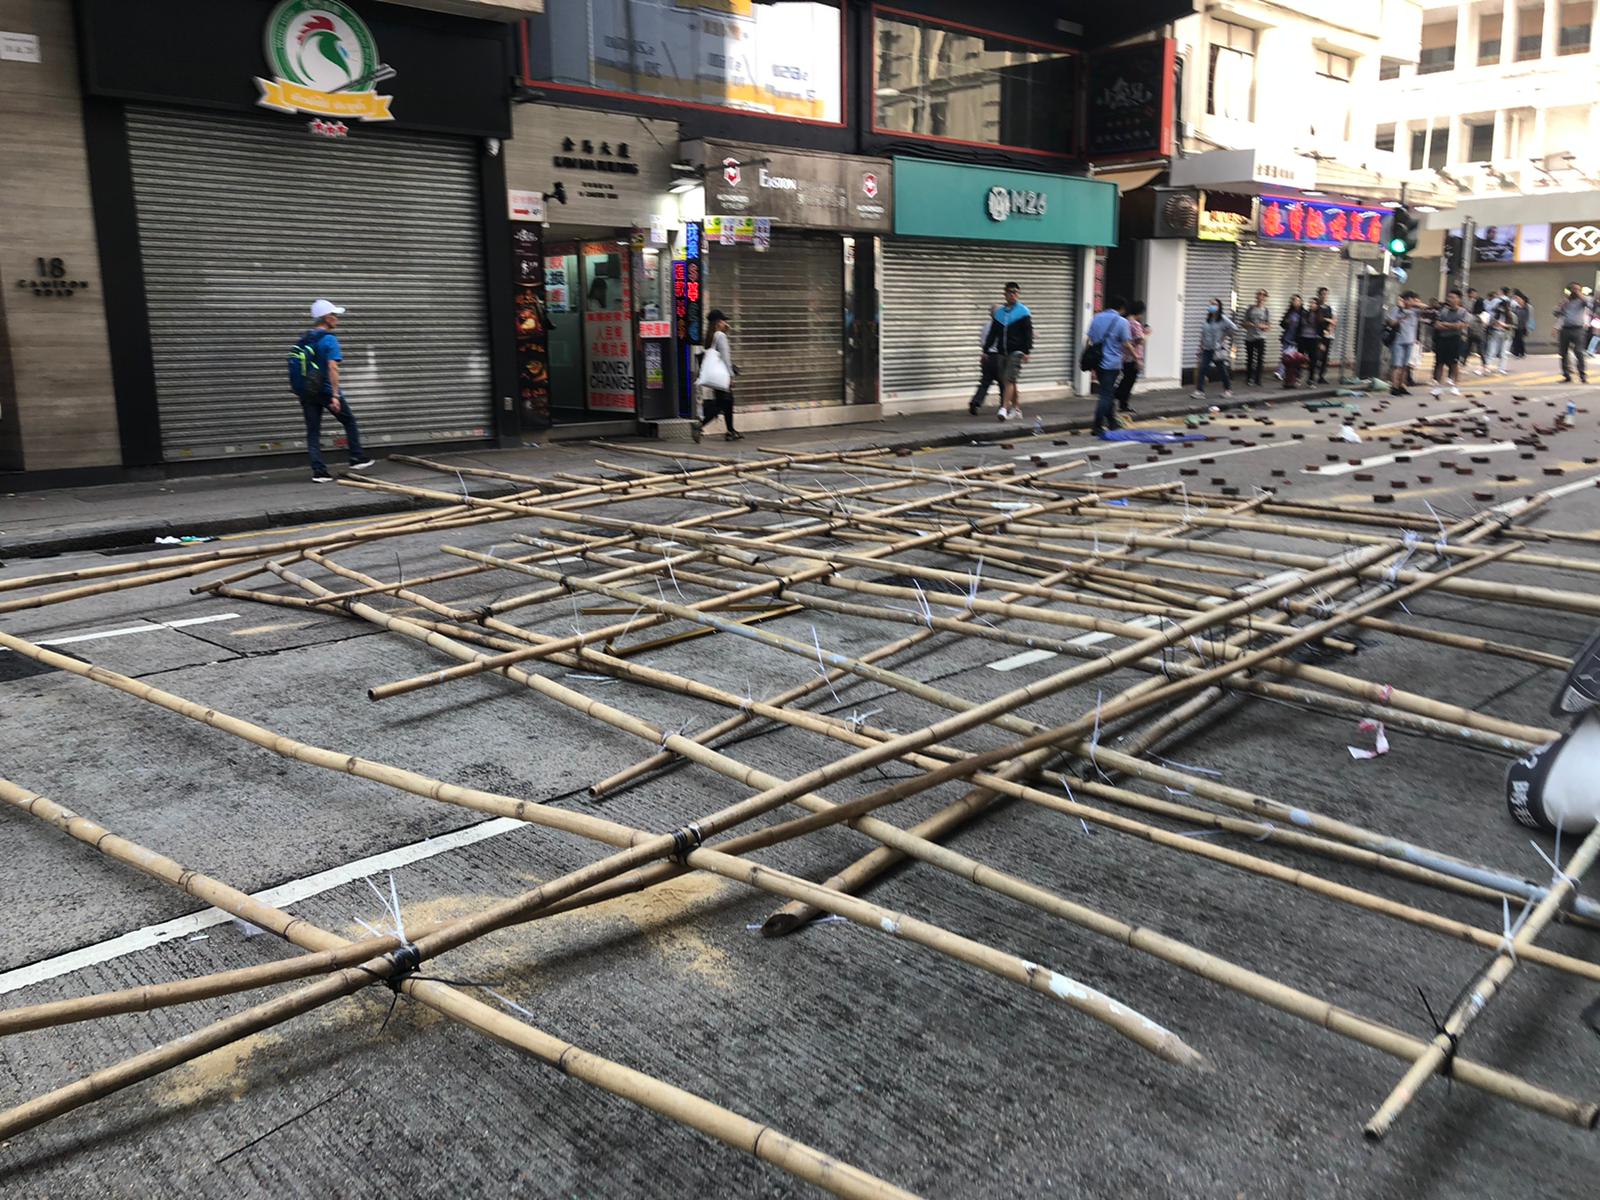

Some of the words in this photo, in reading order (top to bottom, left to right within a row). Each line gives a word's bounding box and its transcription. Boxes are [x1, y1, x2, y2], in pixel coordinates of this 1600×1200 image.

[37, 257, 66, 278] 18
[16, 279, 89, 289] CAMERON
[591, 361, 630, 375] MONEY
[590, 375, 636, 391] CHANGE
